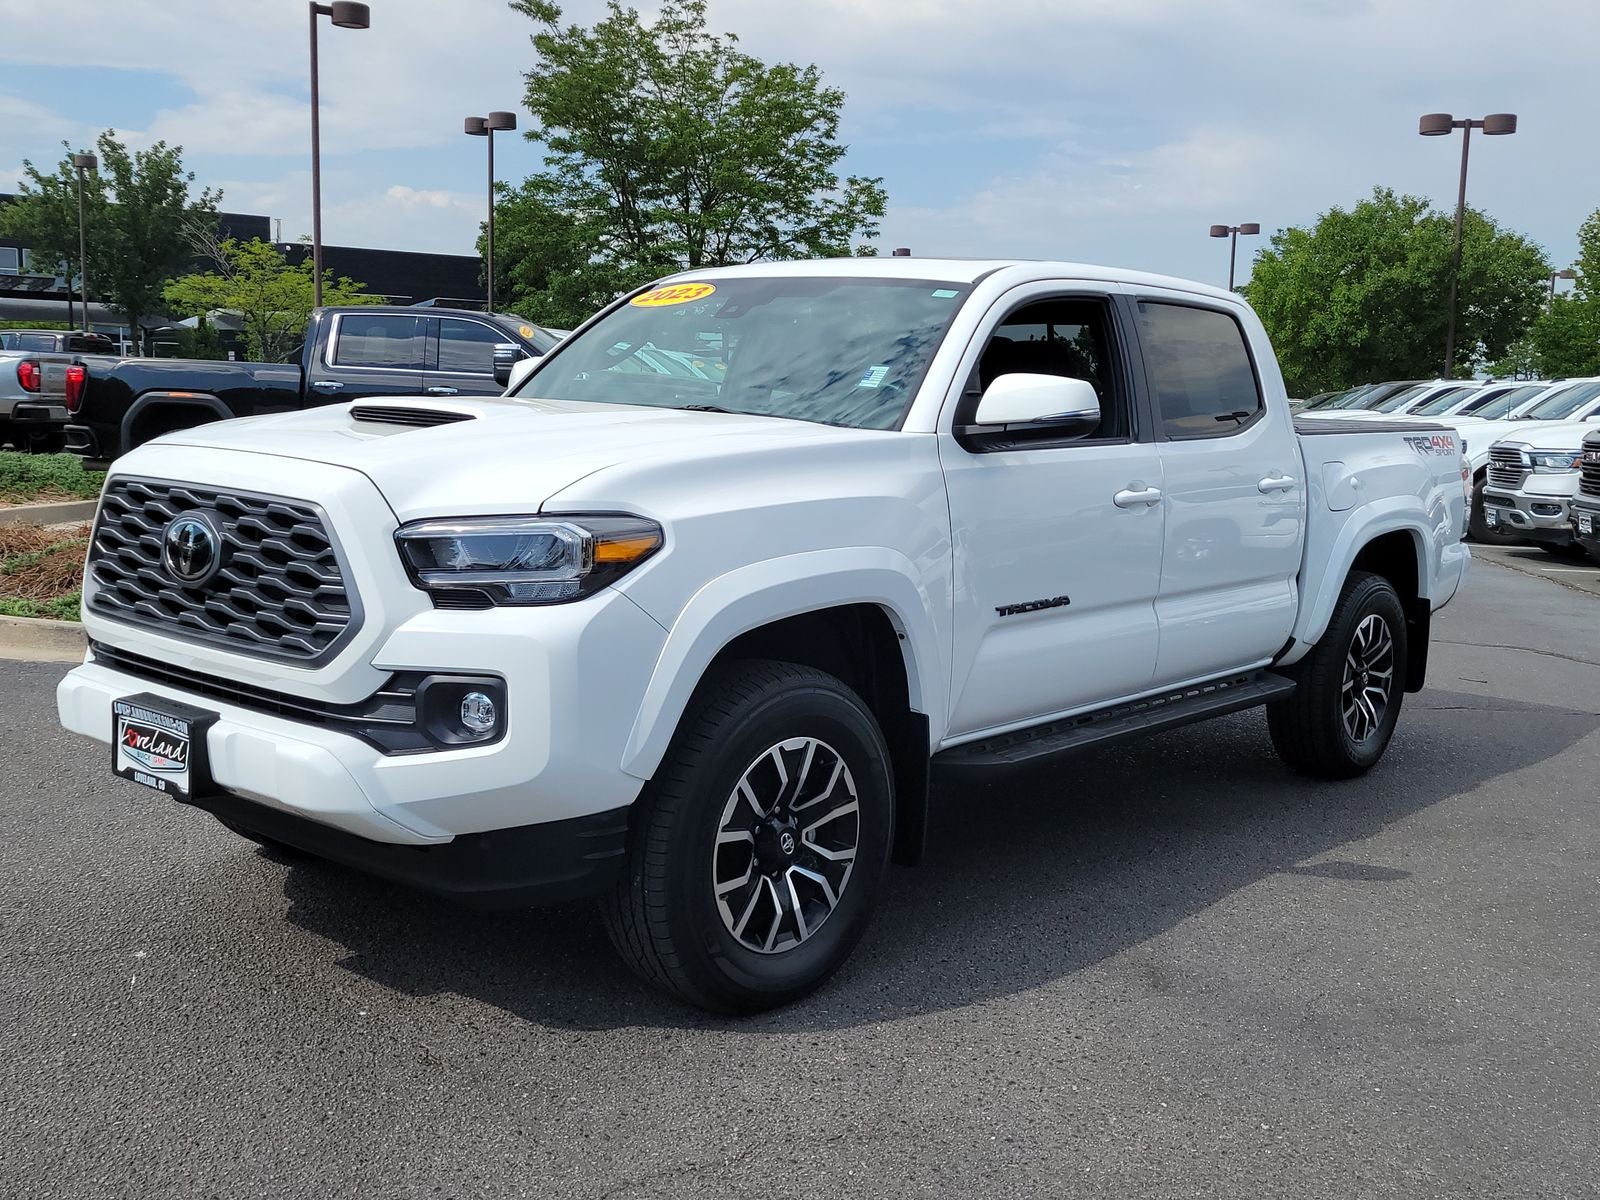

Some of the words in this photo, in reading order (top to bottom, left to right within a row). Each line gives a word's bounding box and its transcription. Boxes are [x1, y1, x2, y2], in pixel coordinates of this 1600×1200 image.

[636, 286, 709, 303] 2023
[1403, 436, 1434, 456] TRD
[1436, 449, 1456, 457] SPORT
[995, 595, 1070, 616] TACOMA
